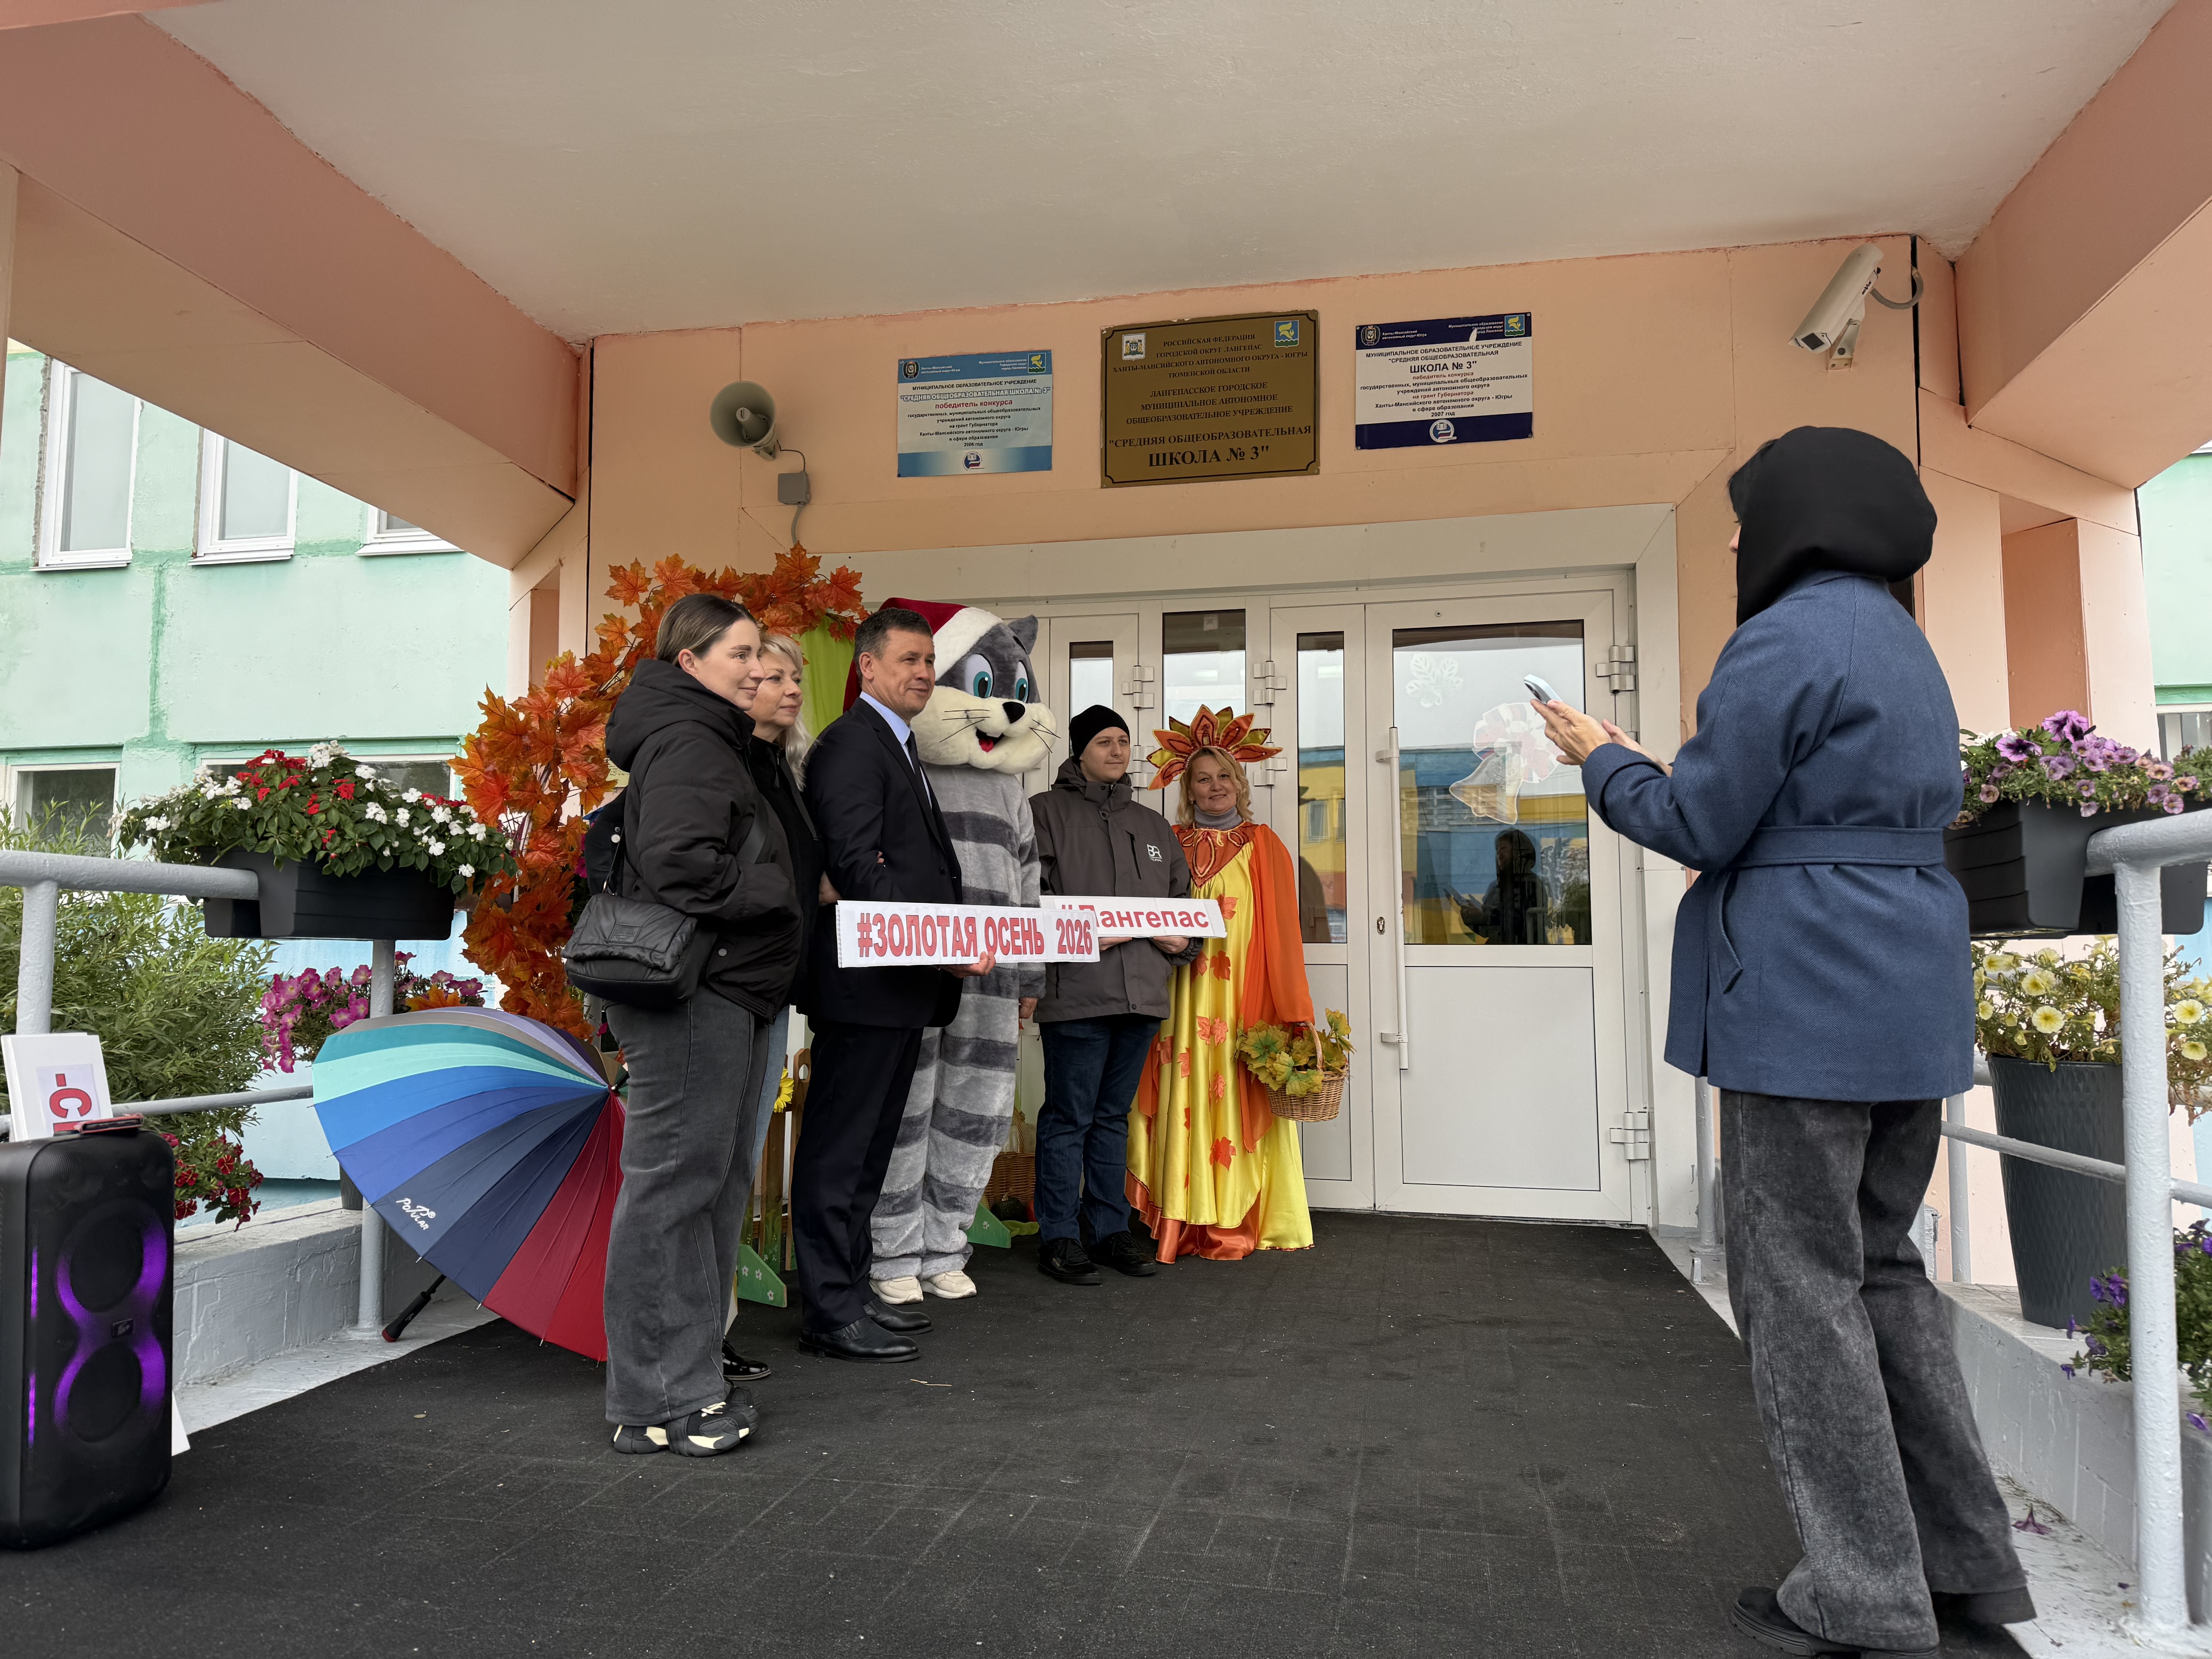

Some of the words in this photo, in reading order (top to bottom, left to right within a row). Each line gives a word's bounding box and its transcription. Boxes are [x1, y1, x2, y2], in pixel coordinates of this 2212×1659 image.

[1164, 338, 1211, 347] РОССИЙСКАЯ
[1213, 334, 1255, 342] ФЕДЕРАЦИЯ
[1157, 349, 1197, 358] ГОРОДСКОЙ
[1224, 344, 1262, 352] ЛАНГЕПАС
[1366, 349, 1418, 357] МУНИЦИПАЛЬНОЕ
[1420, 345, 1479, 354] ОБРАЗОВАТЕЛЬНОЕ
[1421, 350, 1498, 361] ОБЩЕОБРАЗОВАТЕЛЬНАЯ
[1113, 361, 1194, 372] ХАНТЫ-МАНСИЙСКОГО
[1196, 356, 1250, 365] АВТОНОМНОГО
[1410, 363, 1449, 373] ШКОЛА
[1467, 361, 1477, 369] 3"
[1168, 369, 1214, 378] ТЮМЕНСКОЙ
[1217, 367, 1250, 375] ОБЛАСТИ
[1460, 374, 1527, 383] общеобразовательных
[931, 389, 1008, 400] ОБЩЕОБРАЗОВАТЕЛЬНАЯ
[1150, 386, 1215, 397] ЛАНГЕПАССКОЕ
[1219, 382, 1267, 392] ГОРОДСКОЕ
[1141, 398, 1216, 410] МУНИЦИПАЛЬНОЕ
[1219, 394, 1278, 405] АВТОНОМНОЕ
[1126, 410, 1231, 424] ОБЩЕОБРАЗОВАТЕЛЬНОЕ
[1233, 406, 1293, 416] УЧРЕЖДЕНИЕ
[1109, 436, 1165, 447] "СРЕДНЯЯ
[1168, 425, 1311, 444] ОБЩЕОБРАЗОВАТЕЛЬНАЯ
[1149, 449, 1221, 467] ШКОЛА
[1227, 448, 1245, 461] №
[1250, 445, 1269, 460] 3"
[1062, 905, 1209, 928] ангепас
[857, 913, 978, 957] #ЗОЛОТАЯ
[985, 917, 1044, 956] ОСЕНЬ
[1056, 918, 1093, 955] 2026
